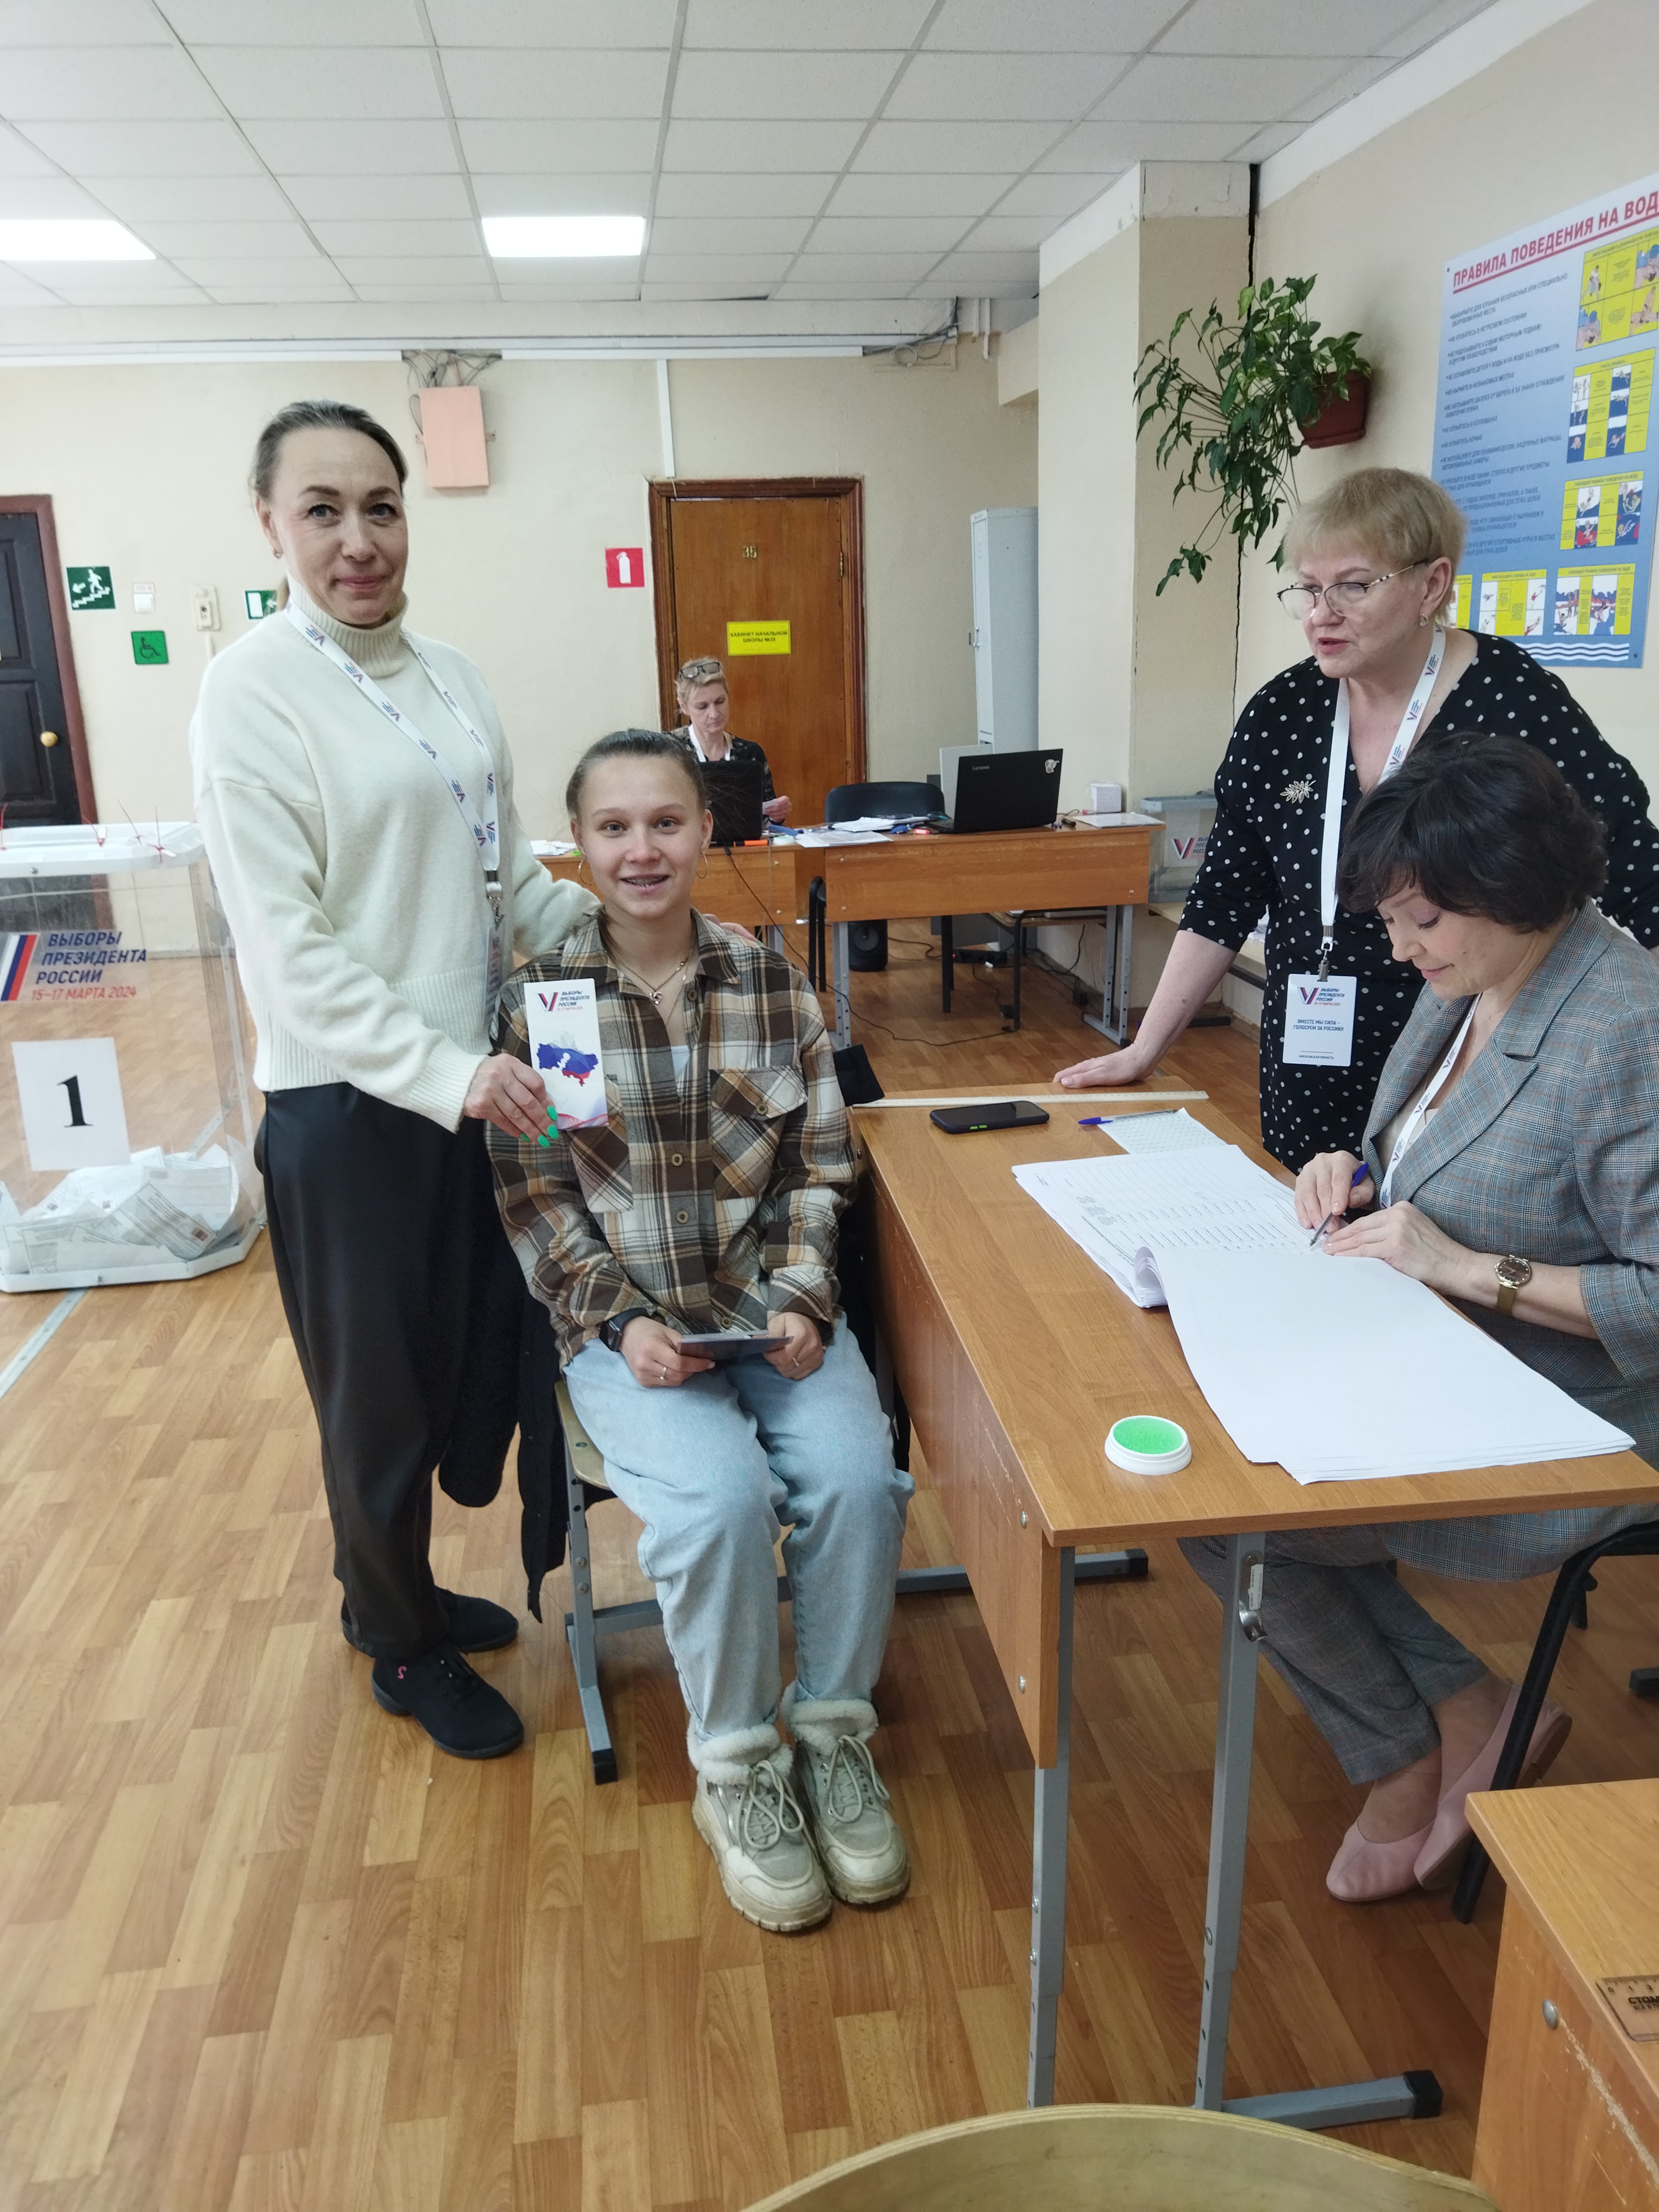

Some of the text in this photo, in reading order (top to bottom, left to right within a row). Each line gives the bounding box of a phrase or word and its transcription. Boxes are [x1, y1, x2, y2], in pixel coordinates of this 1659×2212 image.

[1453, 252, 1506, 288] ПРАВИЛА
[1510, 217, 1594, 264] ПОВЕДЕНИЯ
[1598, 207, 1619, 231] НА
[48, 932, 122, 947] ВЫБОРЫ
[41, 949, 147, 966] ПРЕЗИДЕНТА
[36, 969, 102, 984] РОССИИ
[65, 987, 105, 999] МАРТА
[107, 985, 137, 999] 2024
[56, 1074, 93, 1128] 1
